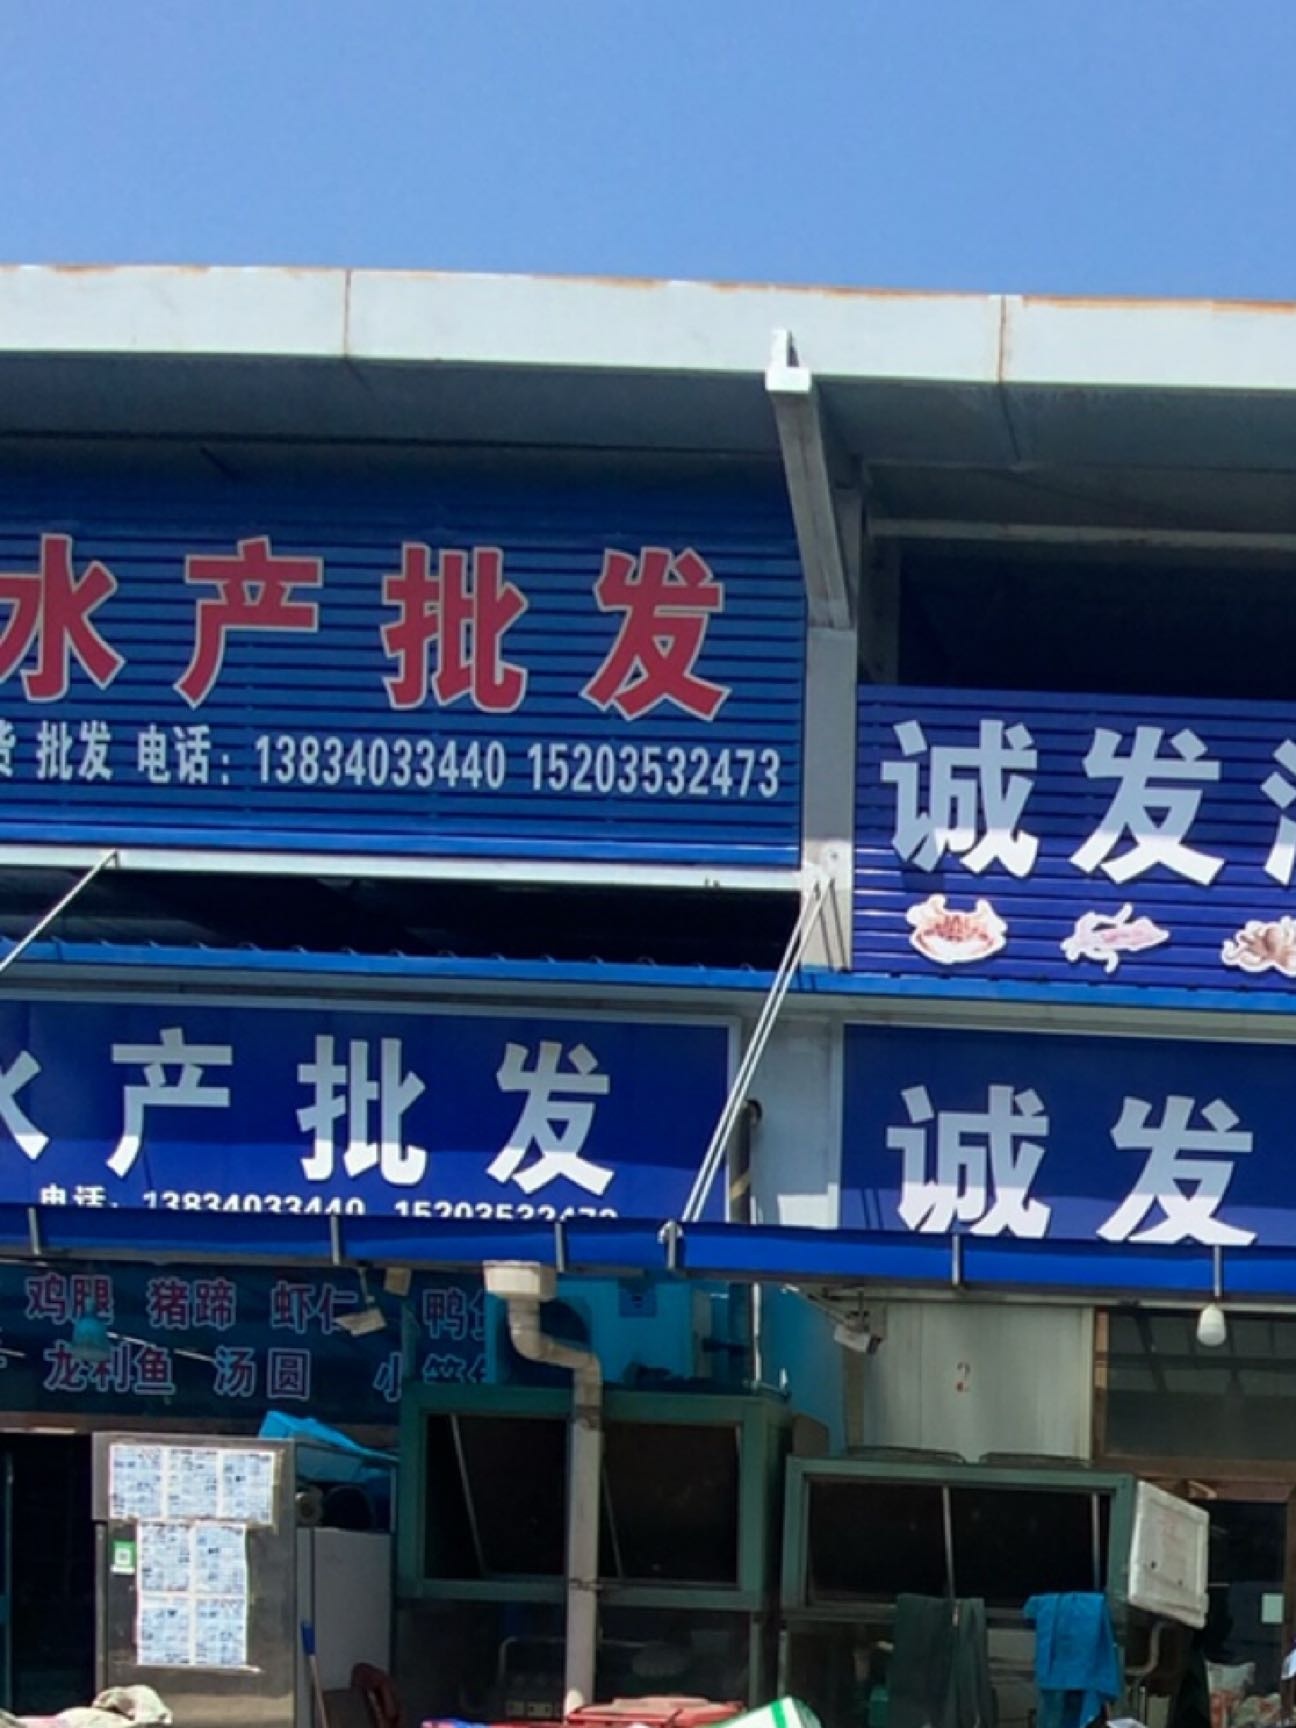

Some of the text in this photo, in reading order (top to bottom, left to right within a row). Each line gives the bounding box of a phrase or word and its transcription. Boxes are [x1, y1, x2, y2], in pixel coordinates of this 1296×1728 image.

[0, 534, 731, 721] 水产批发
[528, 743, 780, 799] 15203532473
[147, 1277, 237, 1331] 猪蹄
[213, 1345, 312, 1401] 汤圆
